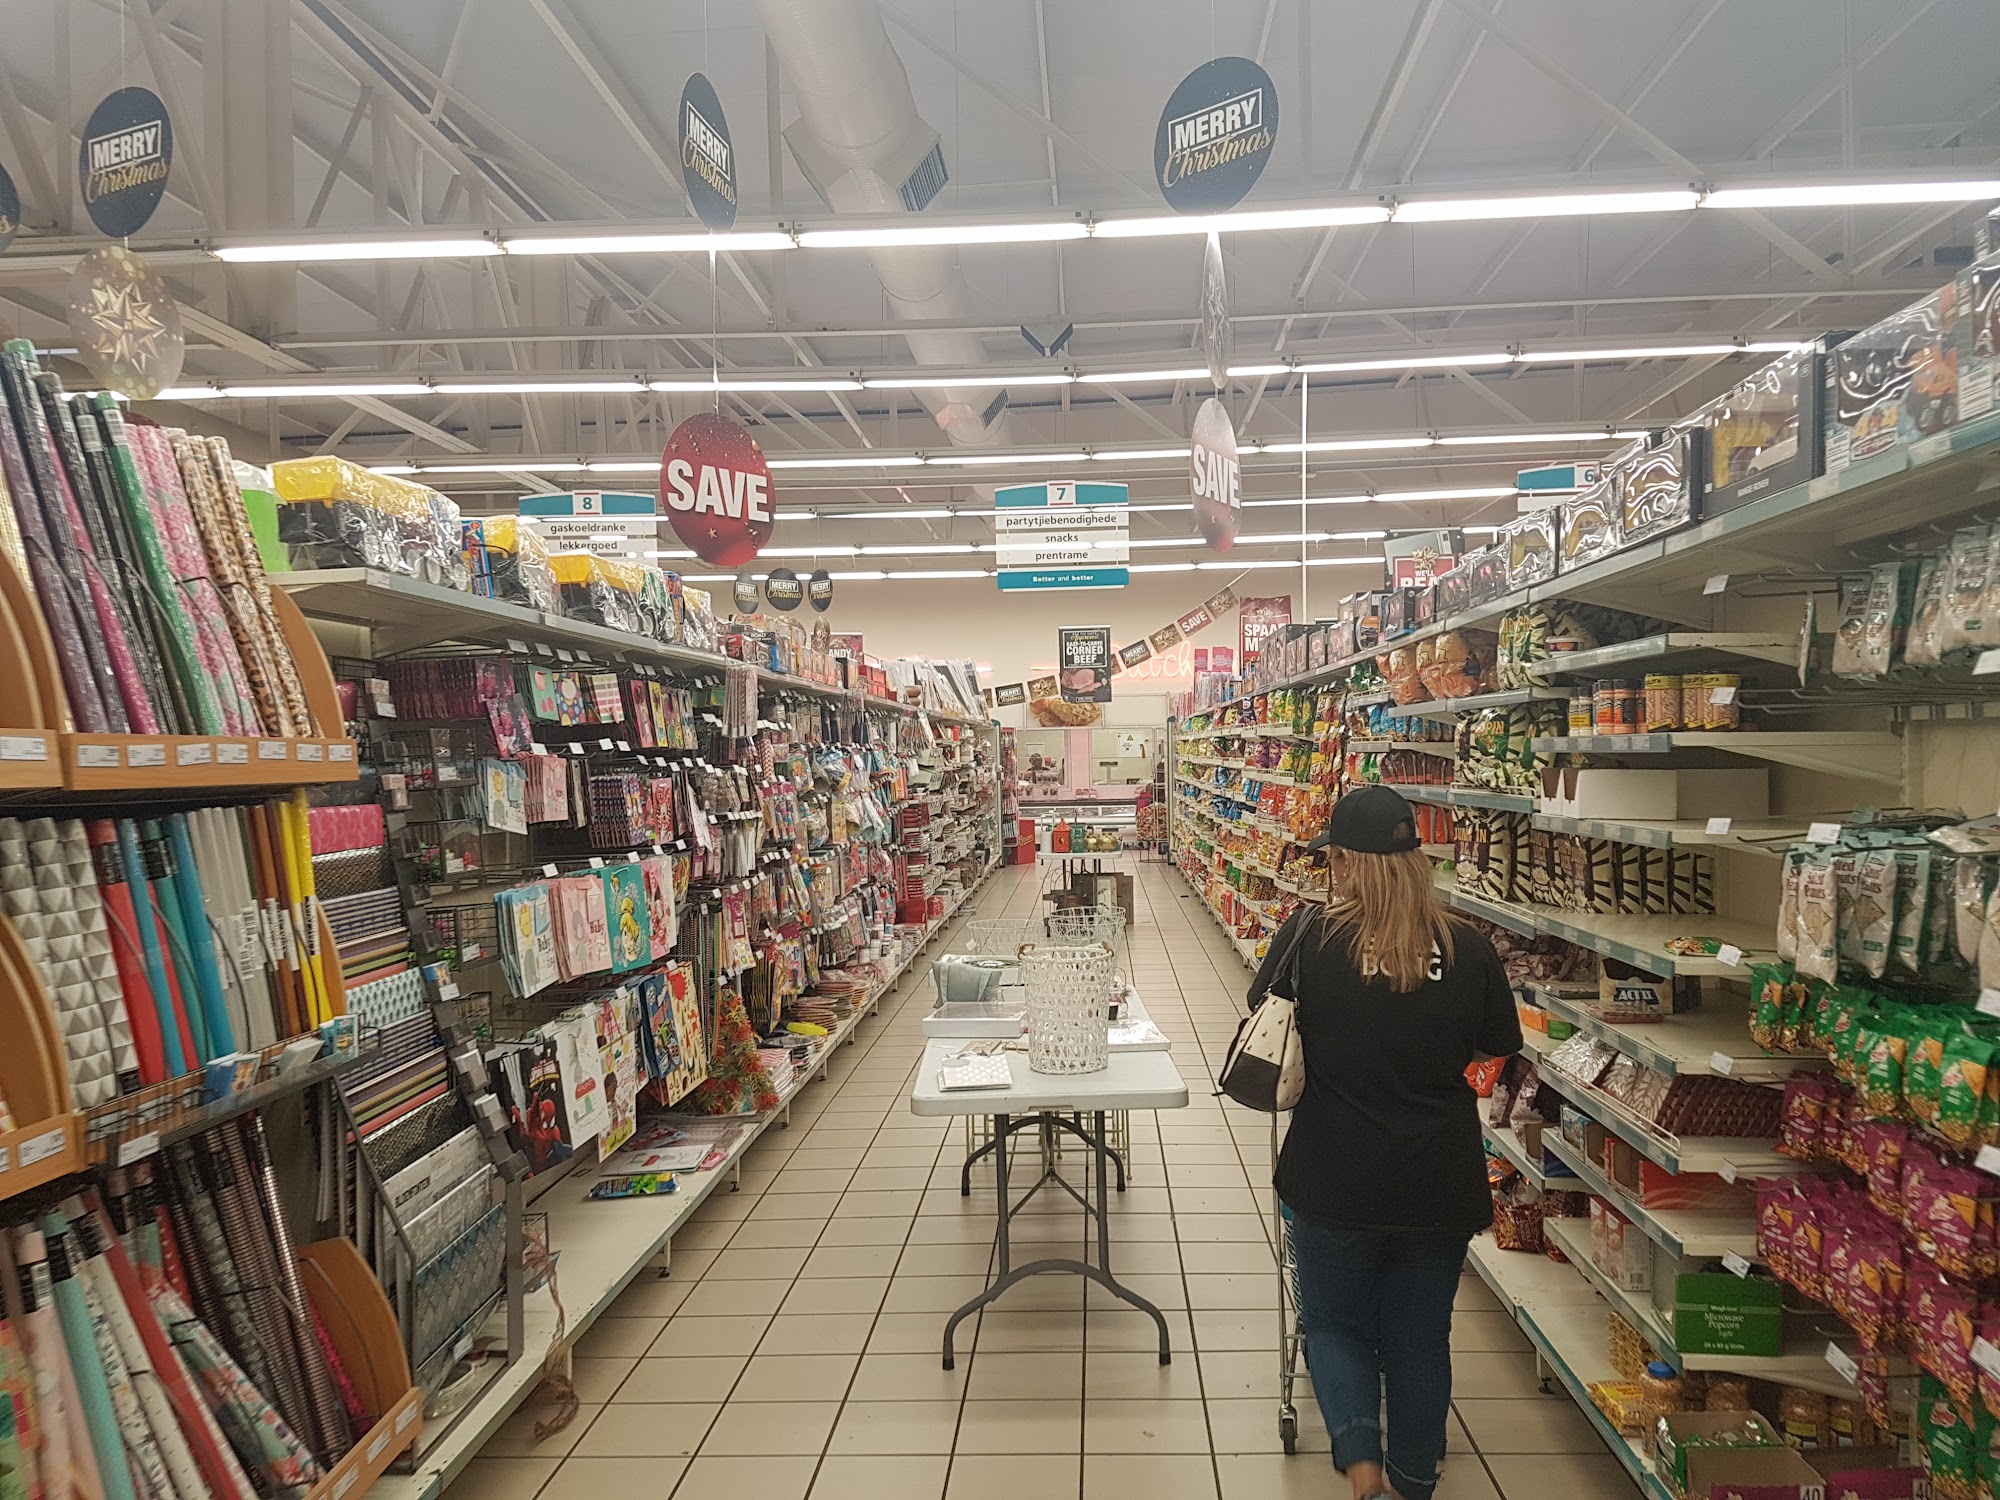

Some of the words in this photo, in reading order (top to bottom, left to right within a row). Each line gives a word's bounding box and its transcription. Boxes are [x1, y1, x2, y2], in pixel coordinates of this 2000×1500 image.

[1175, 96, 1257, 151] MERRY
[689, 110, 727, 171] MERRY
[93, 127, 157, 168] MERRY
[1163, 127, 1274, 188] Christmas
[682, 134, 736, 206] Christmas
[85, 158, 168, 204] Christmas
[1193, 443, 1240, 509] SAVE
[1584, 469, 1594, 482] 6
[667, 459, 770, 522] SAVE
[1056, 487, 1066, 500] 7
[583, 497, 592, 510] 8
[1006, 514, 1117, 527] partytjiebenodighede
[550, 523, 626, 534] gaskoeldranke
[1045, 533, 1079, 542] snacks
[560, 541, 618, 551] lekkergoed
[1035, 551, 1088, 561] prentrame
[771, 581, 797, 590] MERRY
[811, 581, 829, 591] MERRY
[1400, 577, 1438, 587] BEA
[737, 583, 755, 594] MERRY
[767, 589, 802, 599] Christmas
[1182, 610, 1208, 633] SAVE
[1244, 623, 1286, 637] SPAA
[1066, 646, 1103, 656] CORNED
[1125, 644, 1145, 658] MERRY
[1074, 655, 1097, 664] BEEF
[1000, 689, 1020, 697] MERRY
[1618, 990, 1641, 1000] ACT
[1641, 990, 1654, 1000] II
[1704, 1312, 1745, 1323] Microwave
[1708, 1321, 1740, 1332] Popcorn
